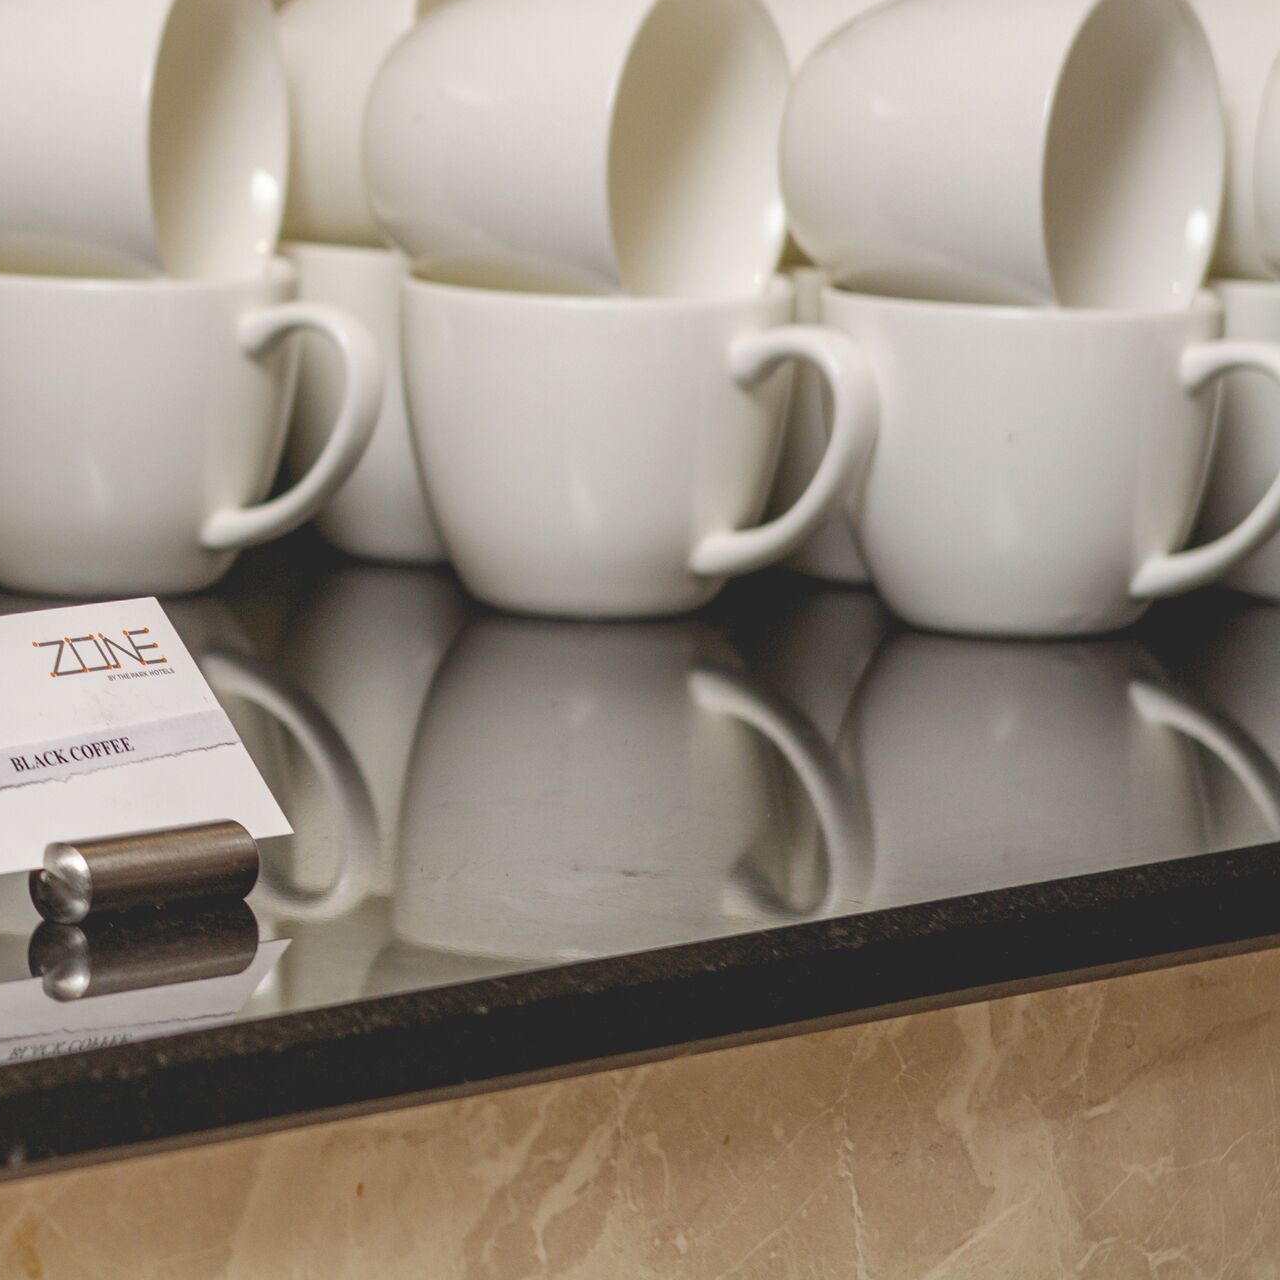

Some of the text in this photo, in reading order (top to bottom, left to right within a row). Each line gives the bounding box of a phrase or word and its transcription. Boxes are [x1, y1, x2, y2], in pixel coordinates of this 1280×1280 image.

[31, 626, 168, 679] ZONE
[107, 667, 176, 682] BY THE PARK HOTELS
[10, 736, 136, 772] BLACK COFFEE
